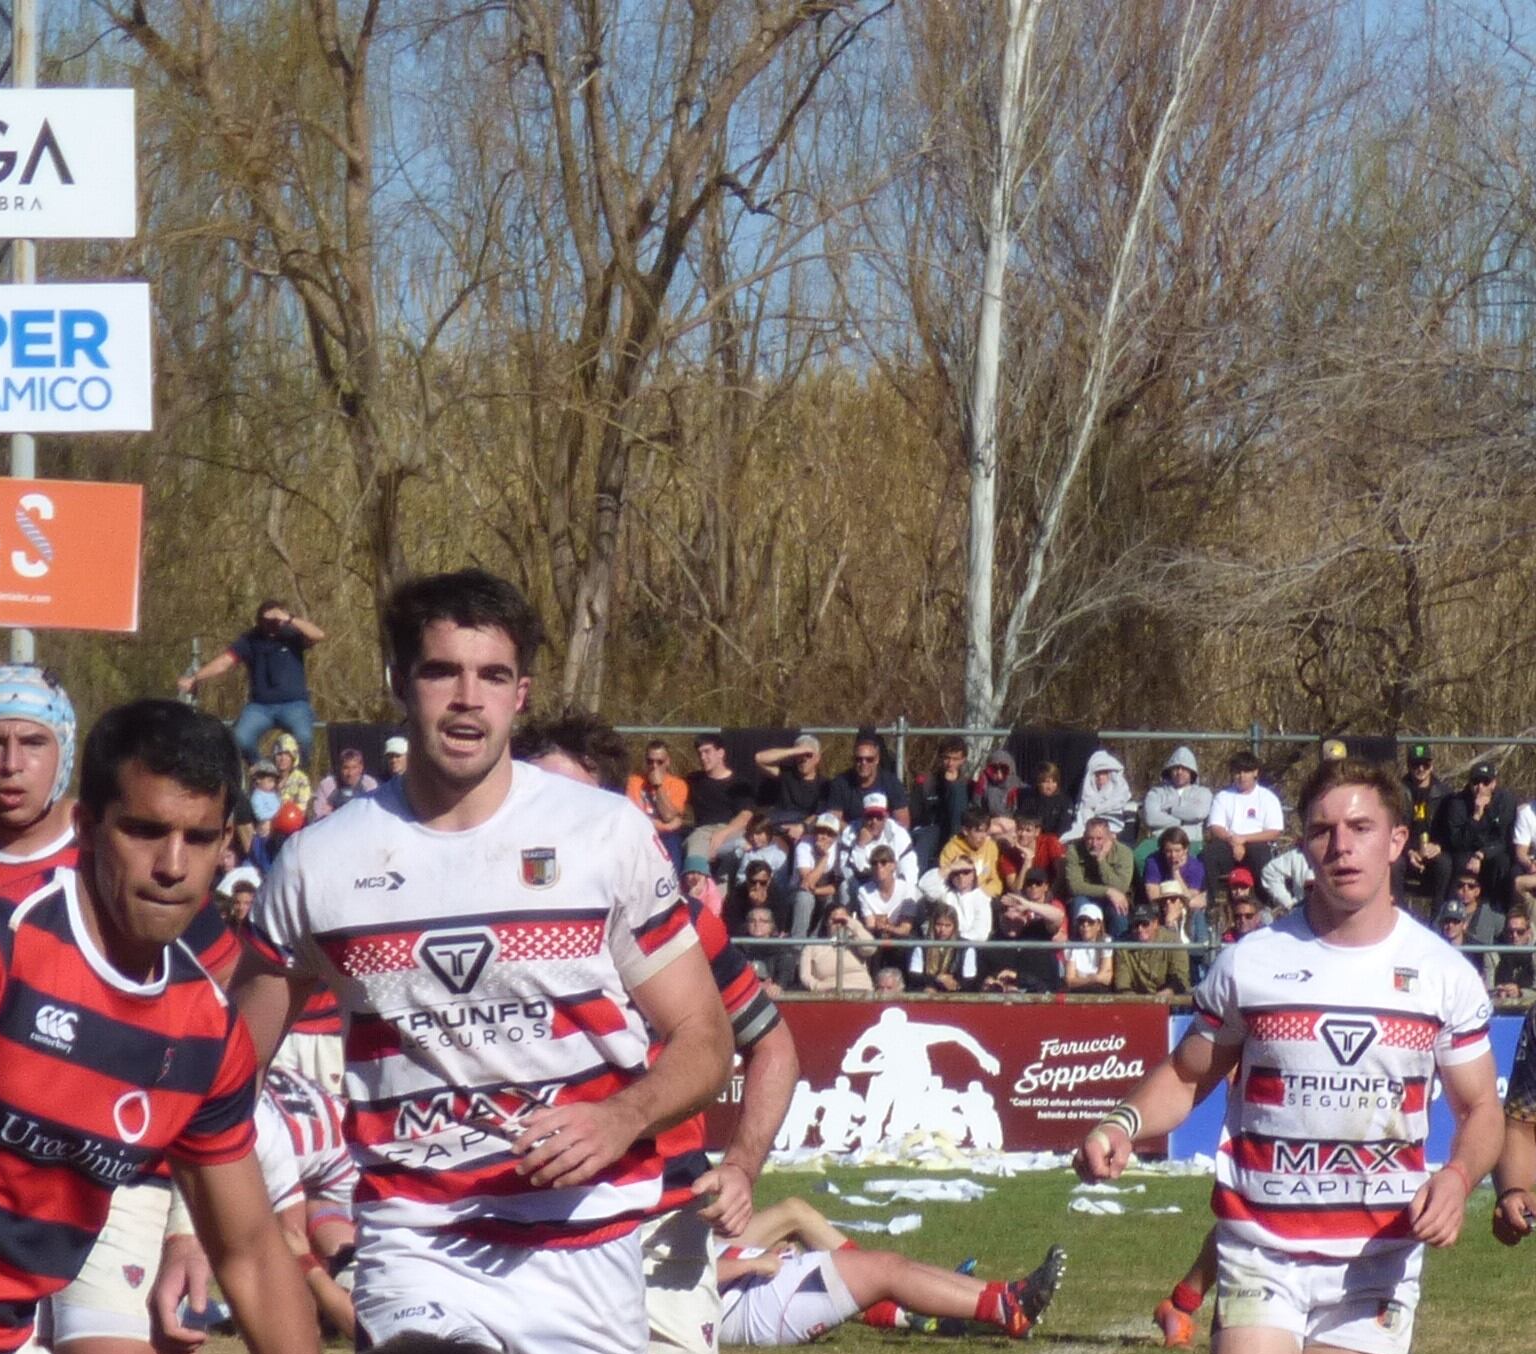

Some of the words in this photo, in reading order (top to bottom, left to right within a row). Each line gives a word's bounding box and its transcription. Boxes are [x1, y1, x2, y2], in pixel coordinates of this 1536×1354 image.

[354, 876, 386, 889] MC3
[388, 1001, 548, 1032] TRIUNFO
[407, 1022, 547, 1052] EGUROS
[1040, 1034, 1126, 1060] Ferruccio
[1014, 1055, 1145, 1093] Soppelsa
[1284, 1074, 1404, 1095] TRIUNFO
[1287, 1092, 1399, 1109] SEGUROS
[1274, 1141, 1409, 1174] MAX
[1263, 1178, 1416, 1197] CAPITAL
[393, 1306, 427, 1321] MC3
